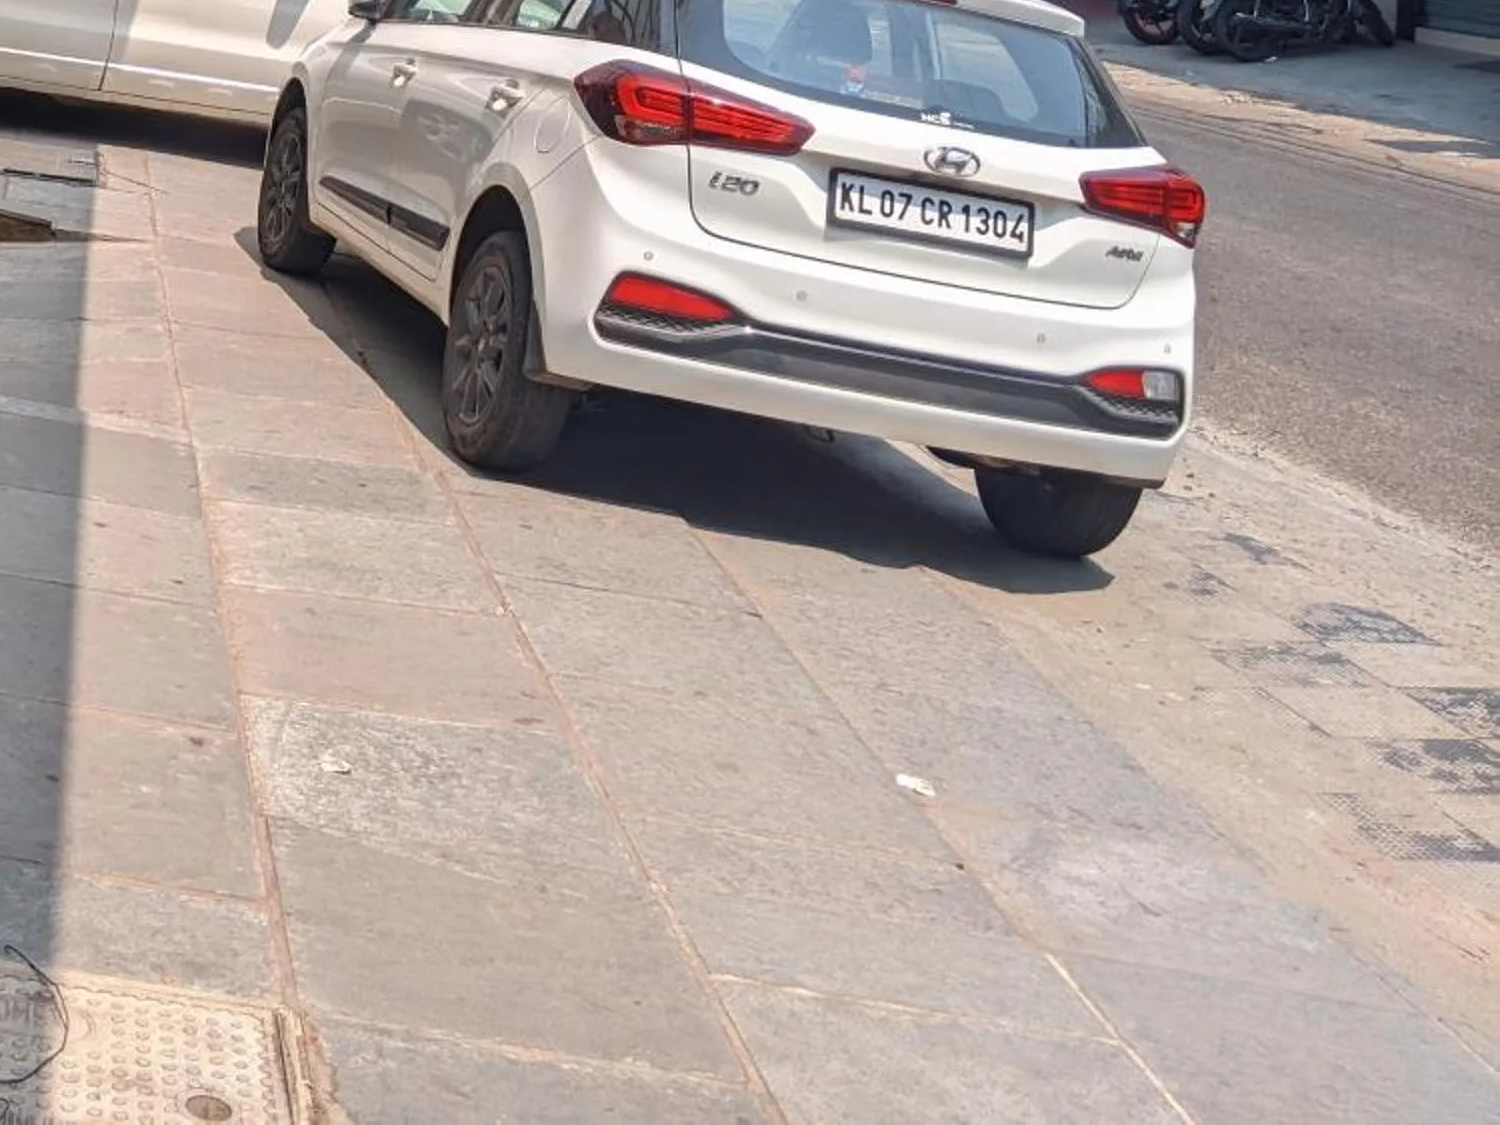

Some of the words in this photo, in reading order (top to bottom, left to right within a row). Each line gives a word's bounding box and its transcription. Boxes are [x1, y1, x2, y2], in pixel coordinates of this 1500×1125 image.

[708, 171, 760, 195] i20
[839, 181, 873, 216] KL
[879, 189, 913, 222] 07
[920, 196, 953, 230] CR
[961, 203, 1025, 244] 1304
